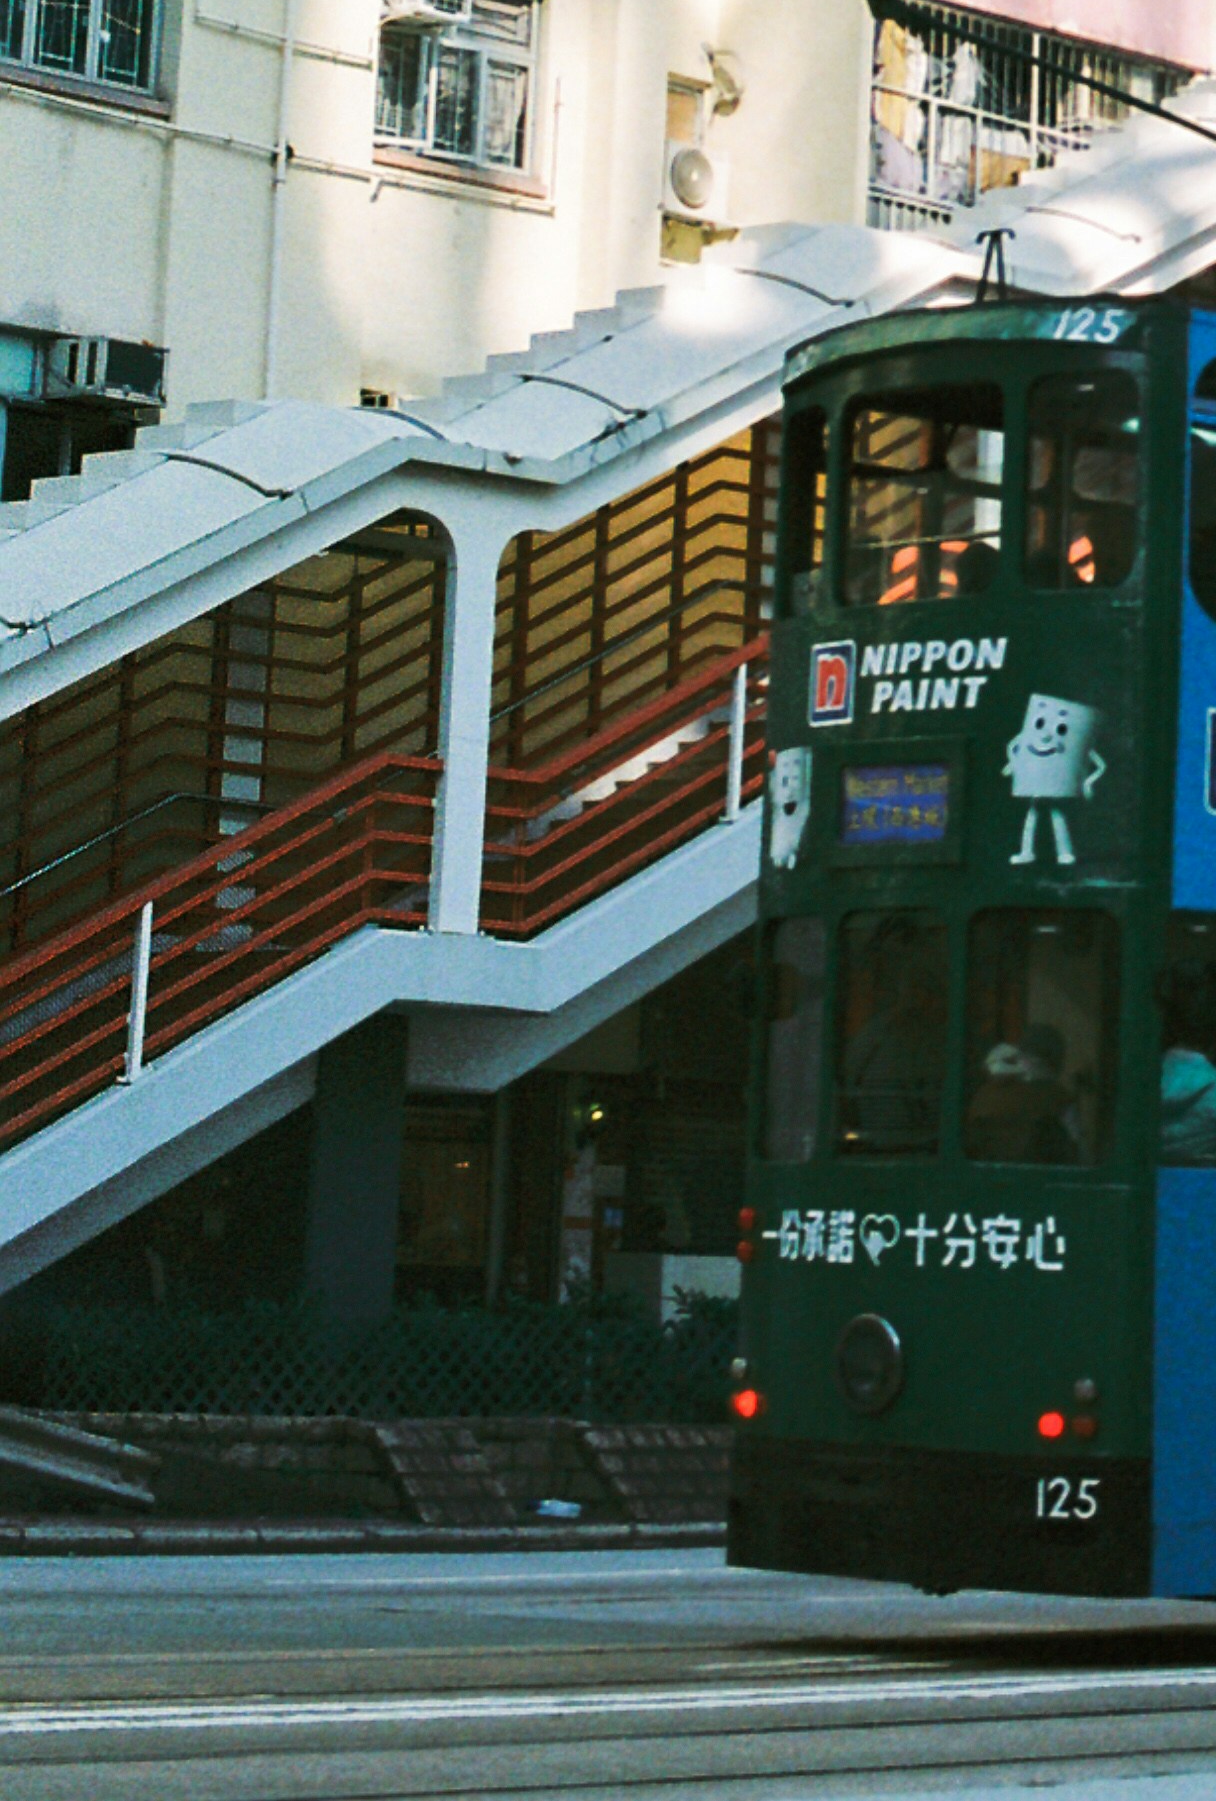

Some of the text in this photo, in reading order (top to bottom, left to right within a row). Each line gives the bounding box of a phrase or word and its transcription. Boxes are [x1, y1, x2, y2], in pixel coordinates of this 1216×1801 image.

[1052, 309, 1126, 343] 125
[860, 637, 1008, 677] NIPPON
[871, 675, 988, 714] PAINT
[762, 1209, 1067, 1271] 一份承諾 十分安心
[1036, 1477, 1100, 1519] 125
